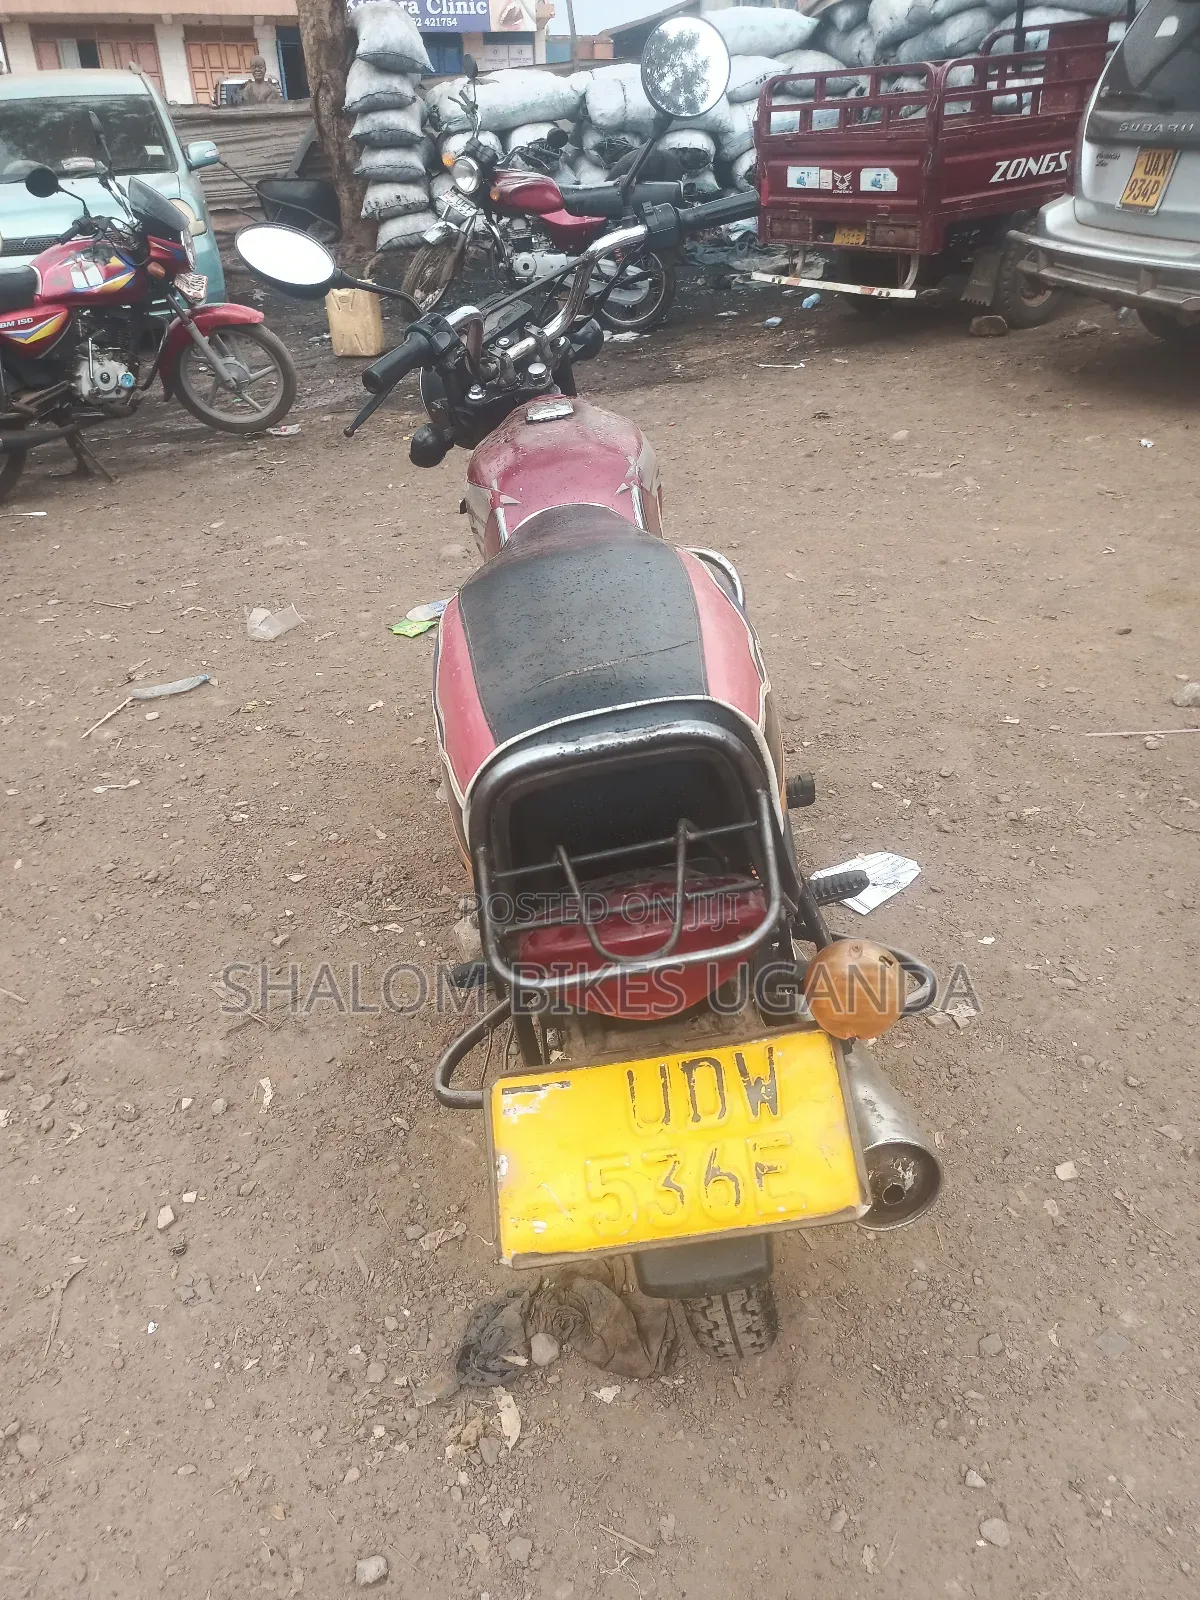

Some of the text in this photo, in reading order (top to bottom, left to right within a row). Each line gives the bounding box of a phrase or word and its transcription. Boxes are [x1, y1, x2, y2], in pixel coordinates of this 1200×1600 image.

[426, 0, 488, 15] Clinic
[424, 18, 458, 27] 421754
[1119, 122, 1194, 133] SUBARU
[989, 150, 1072, 183] ZONGS
[1143, 151, 1172, 177] UAX
[1125, 178, 1160, 203] 934P
[624, 1044, 781, 1136] UDW
[584, 1132, 807, 1236] 536E
